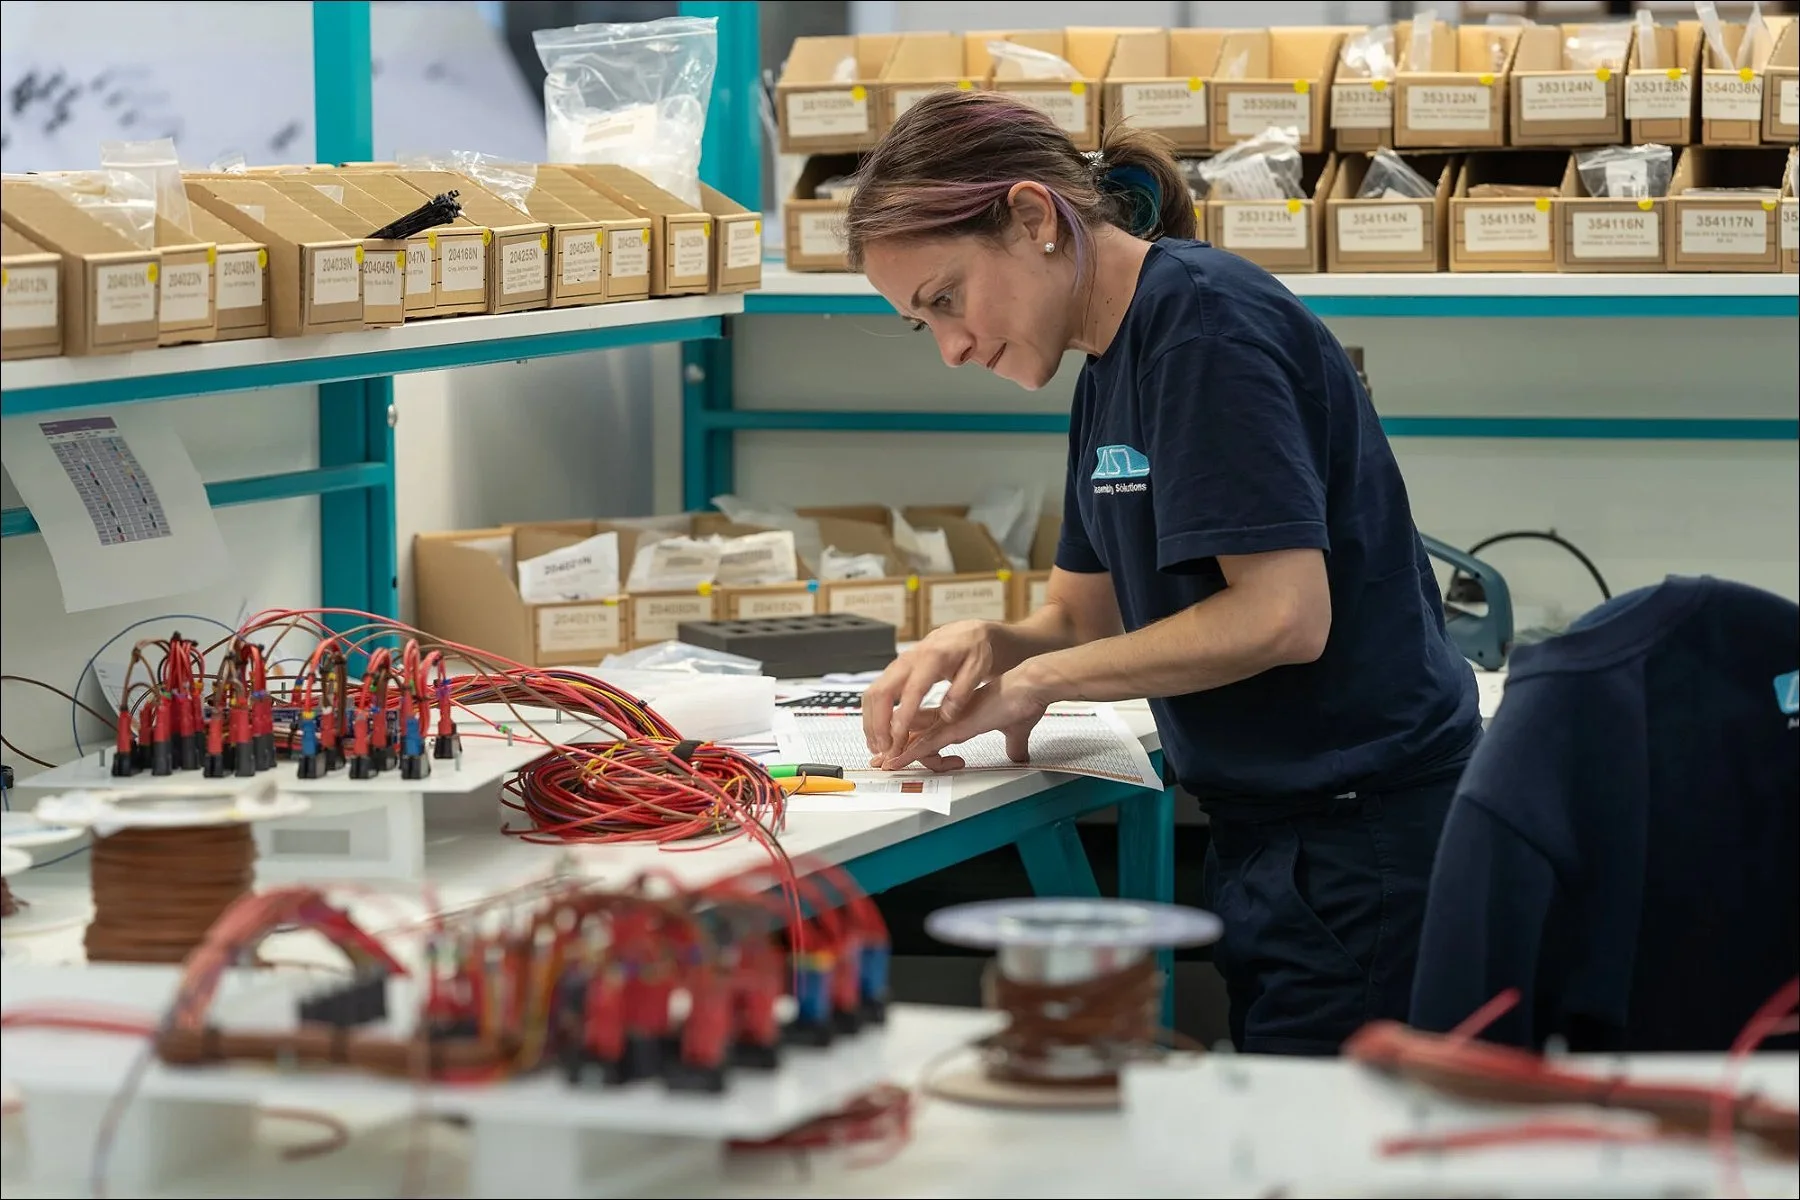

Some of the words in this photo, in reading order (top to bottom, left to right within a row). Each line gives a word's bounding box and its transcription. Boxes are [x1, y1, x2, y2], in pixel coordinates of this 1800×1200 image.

[1537, 81, 1593, 93] 353124N
[1705, 82, 1761, 95] 354038N
[1422, 91, 1477, 105] 353123N
[1479, 213, 1537, 226] 354115N
[1587, 217, 1645, 230] 354116N
[1696, 214, 1754, 228] 354117N
[363, 261, 395, 274] 204045N
[1115, 483, 1147, 493] Solutions
